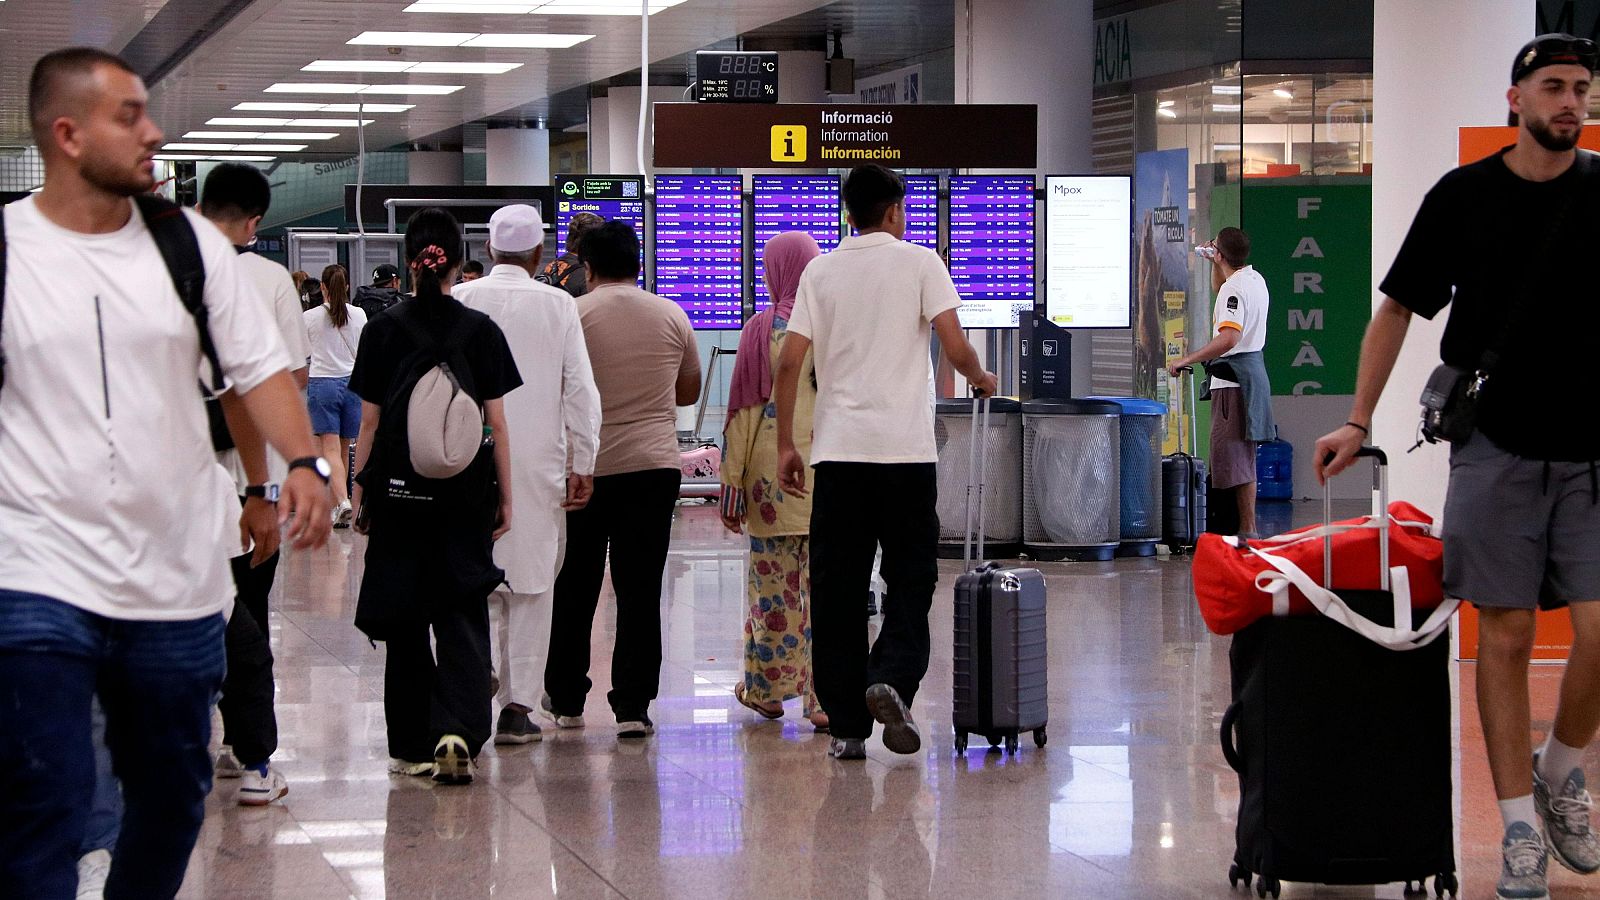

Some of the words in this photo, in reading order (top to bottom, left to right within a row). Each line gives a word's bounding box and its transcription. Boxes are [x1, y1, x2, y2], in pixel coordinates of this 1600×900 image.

[821, 110, 893, 124] Informació
[821, 128, 889, 142] Information
[821, 145, 901, 159] Información
[1054, 184, 1082, 197] Mpox
[571, 203, 600, 211] Sortides
[1167, 226, 1184, 240] RICOLA
